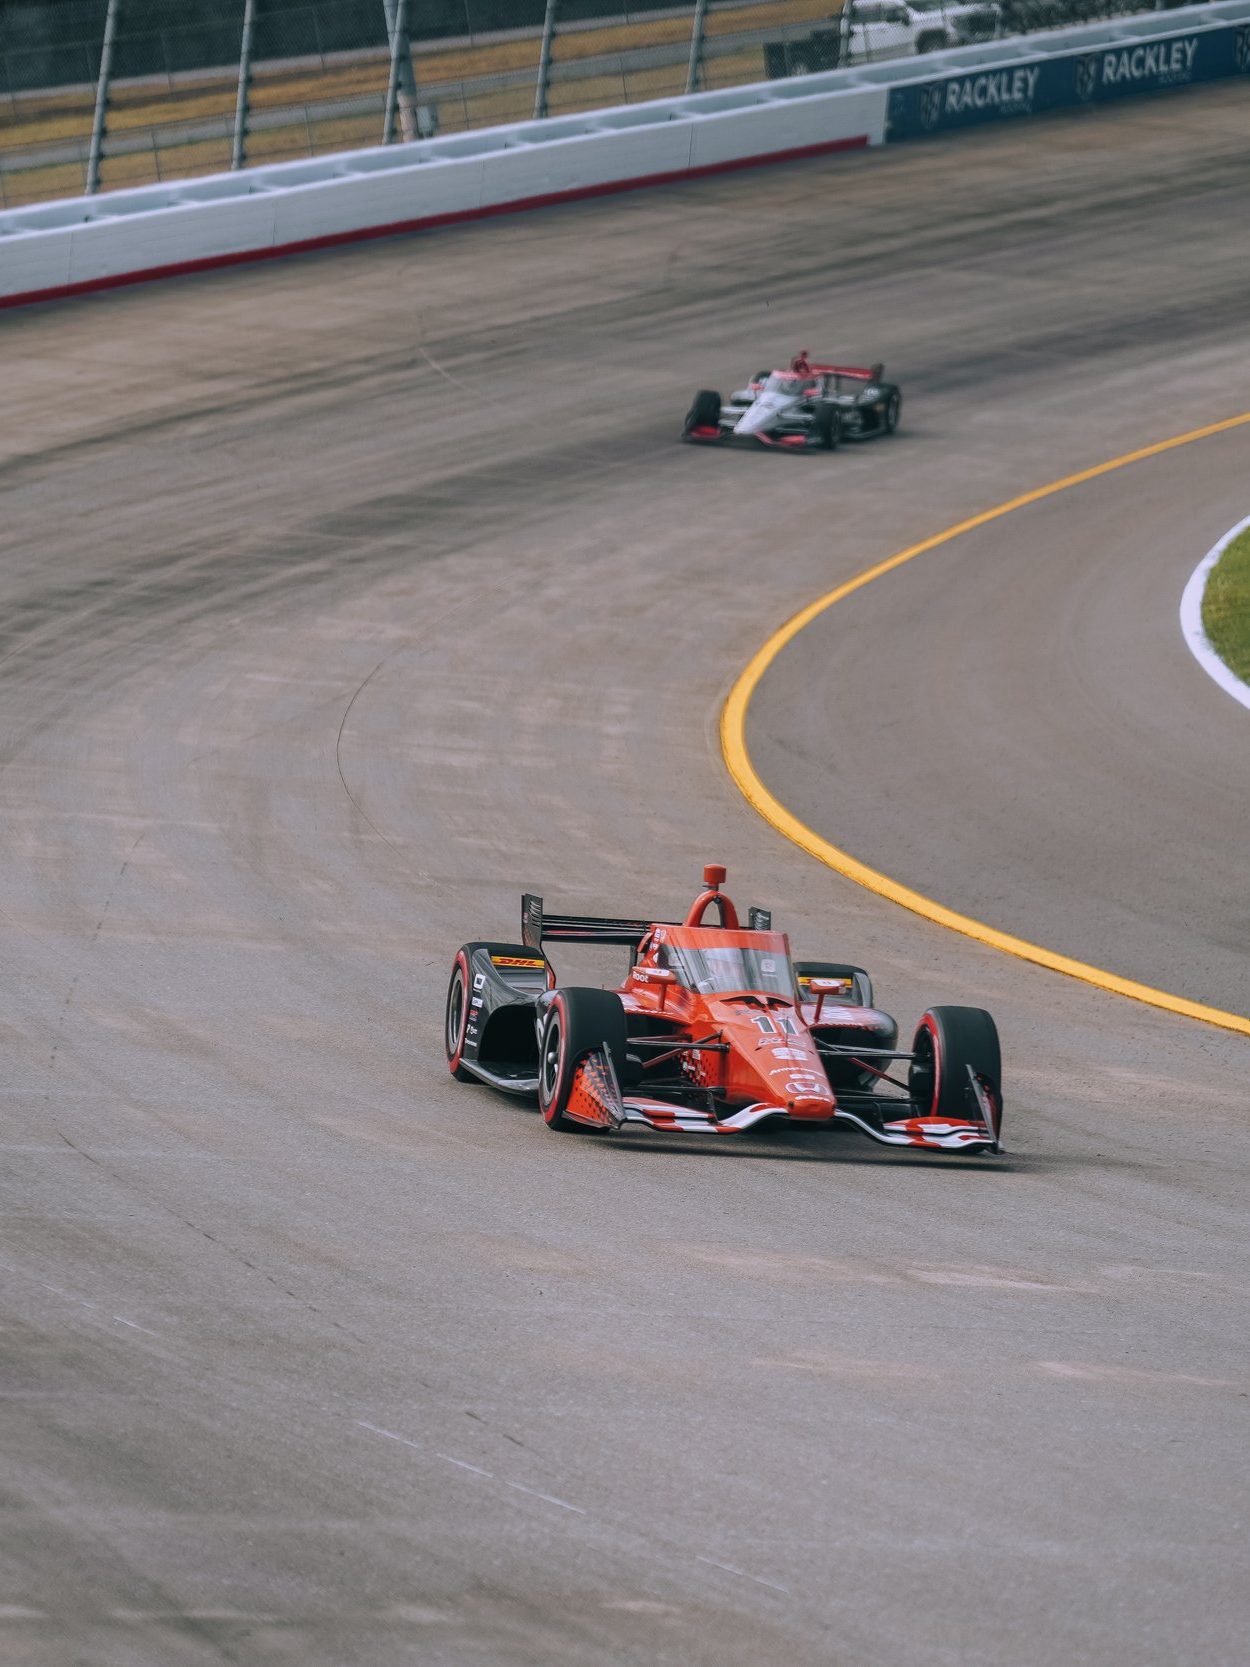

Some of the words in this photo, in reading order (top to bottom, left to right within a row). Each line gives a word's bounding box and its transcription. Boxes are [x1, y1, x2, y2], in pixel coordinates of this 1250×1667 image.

[1102, 38, 1199, 84] RACKLEY
[945, 66, 1040, 113] RACKLEY
[498, 957, 537, 967] DHL
[750, 1016, 799, 1037] 11
